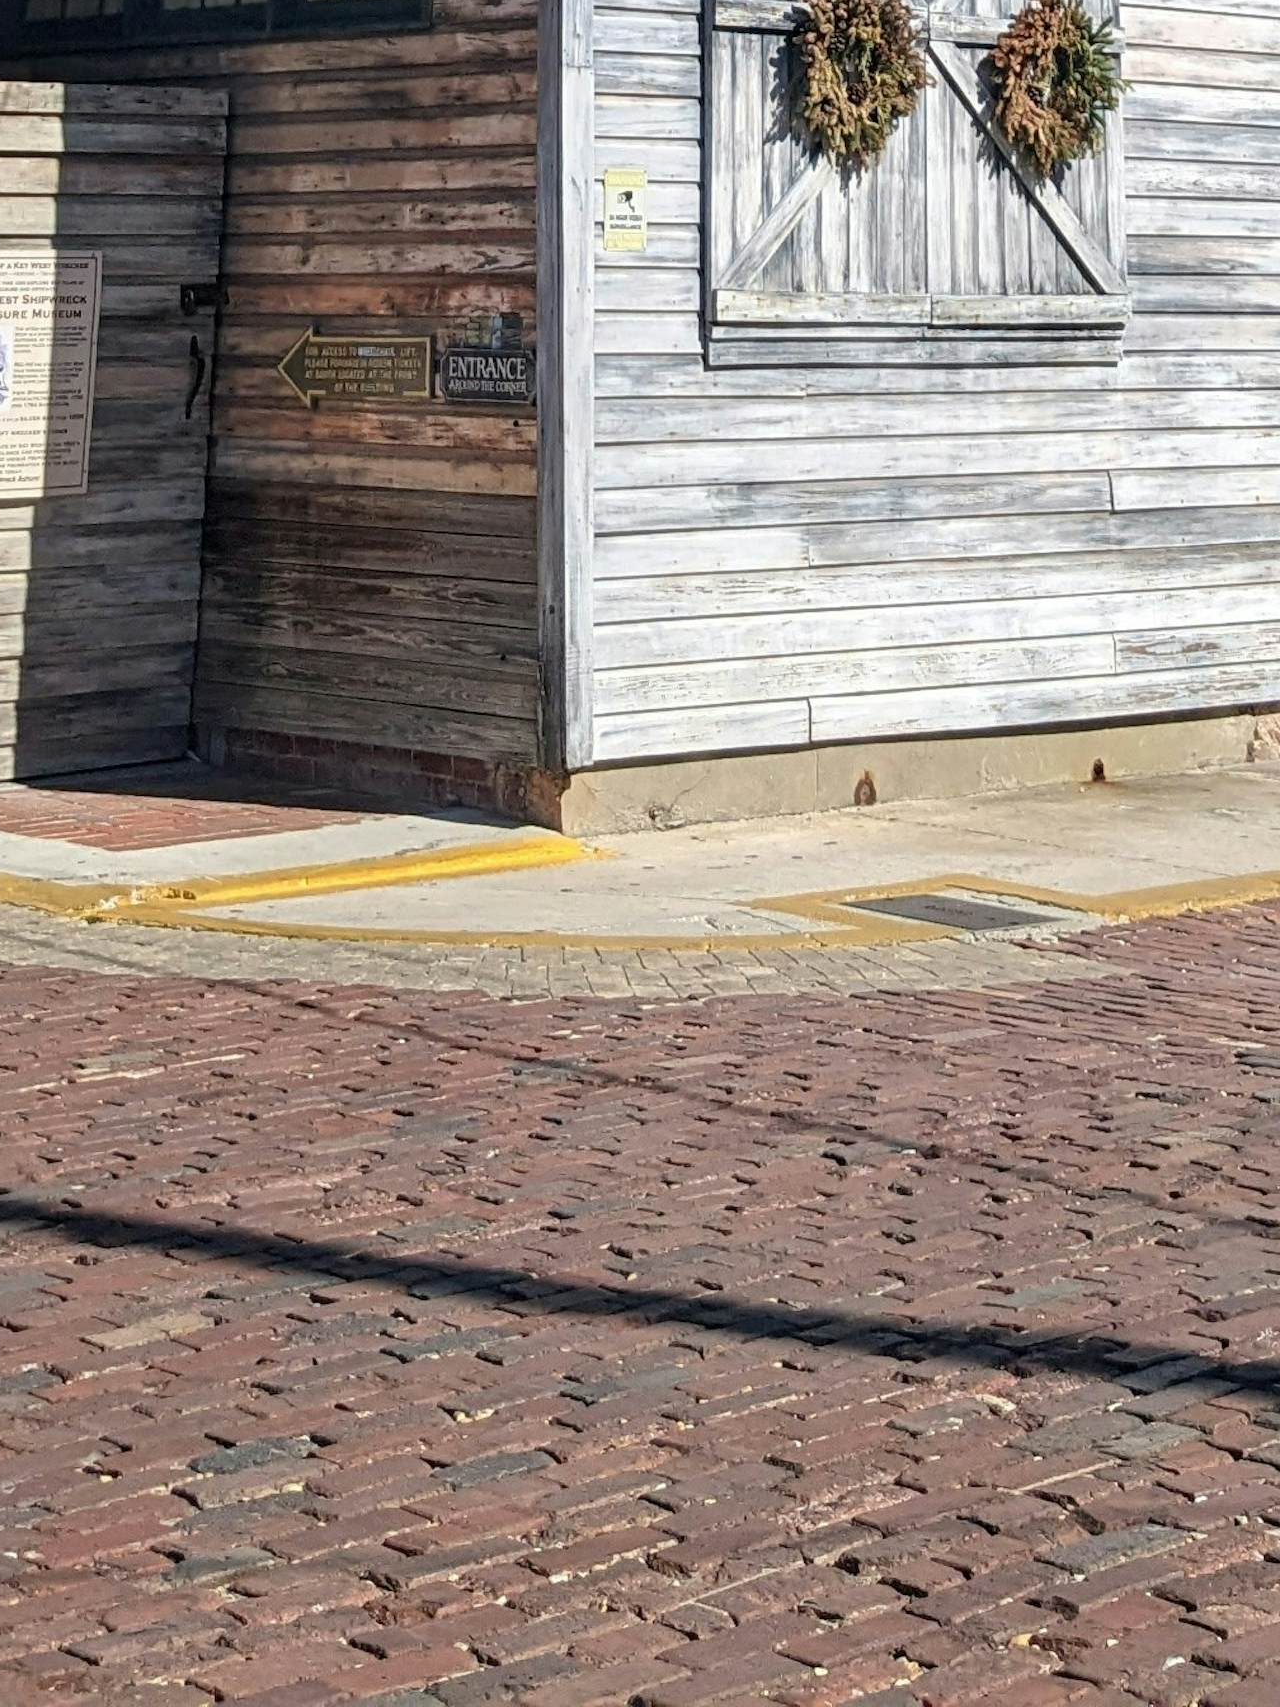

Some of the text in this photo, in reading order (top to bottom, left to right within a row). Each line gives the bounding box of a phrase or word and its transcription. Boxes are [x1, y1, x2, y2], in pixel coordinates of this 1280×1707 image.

[22, 294, 88, 305] SHIPWRECK
[32, 308, 82, 319] MUSEUM
[448, 356, 527, 380] ENTRANCE
[447, 379, 528, 396] AROUND THE CORNER
